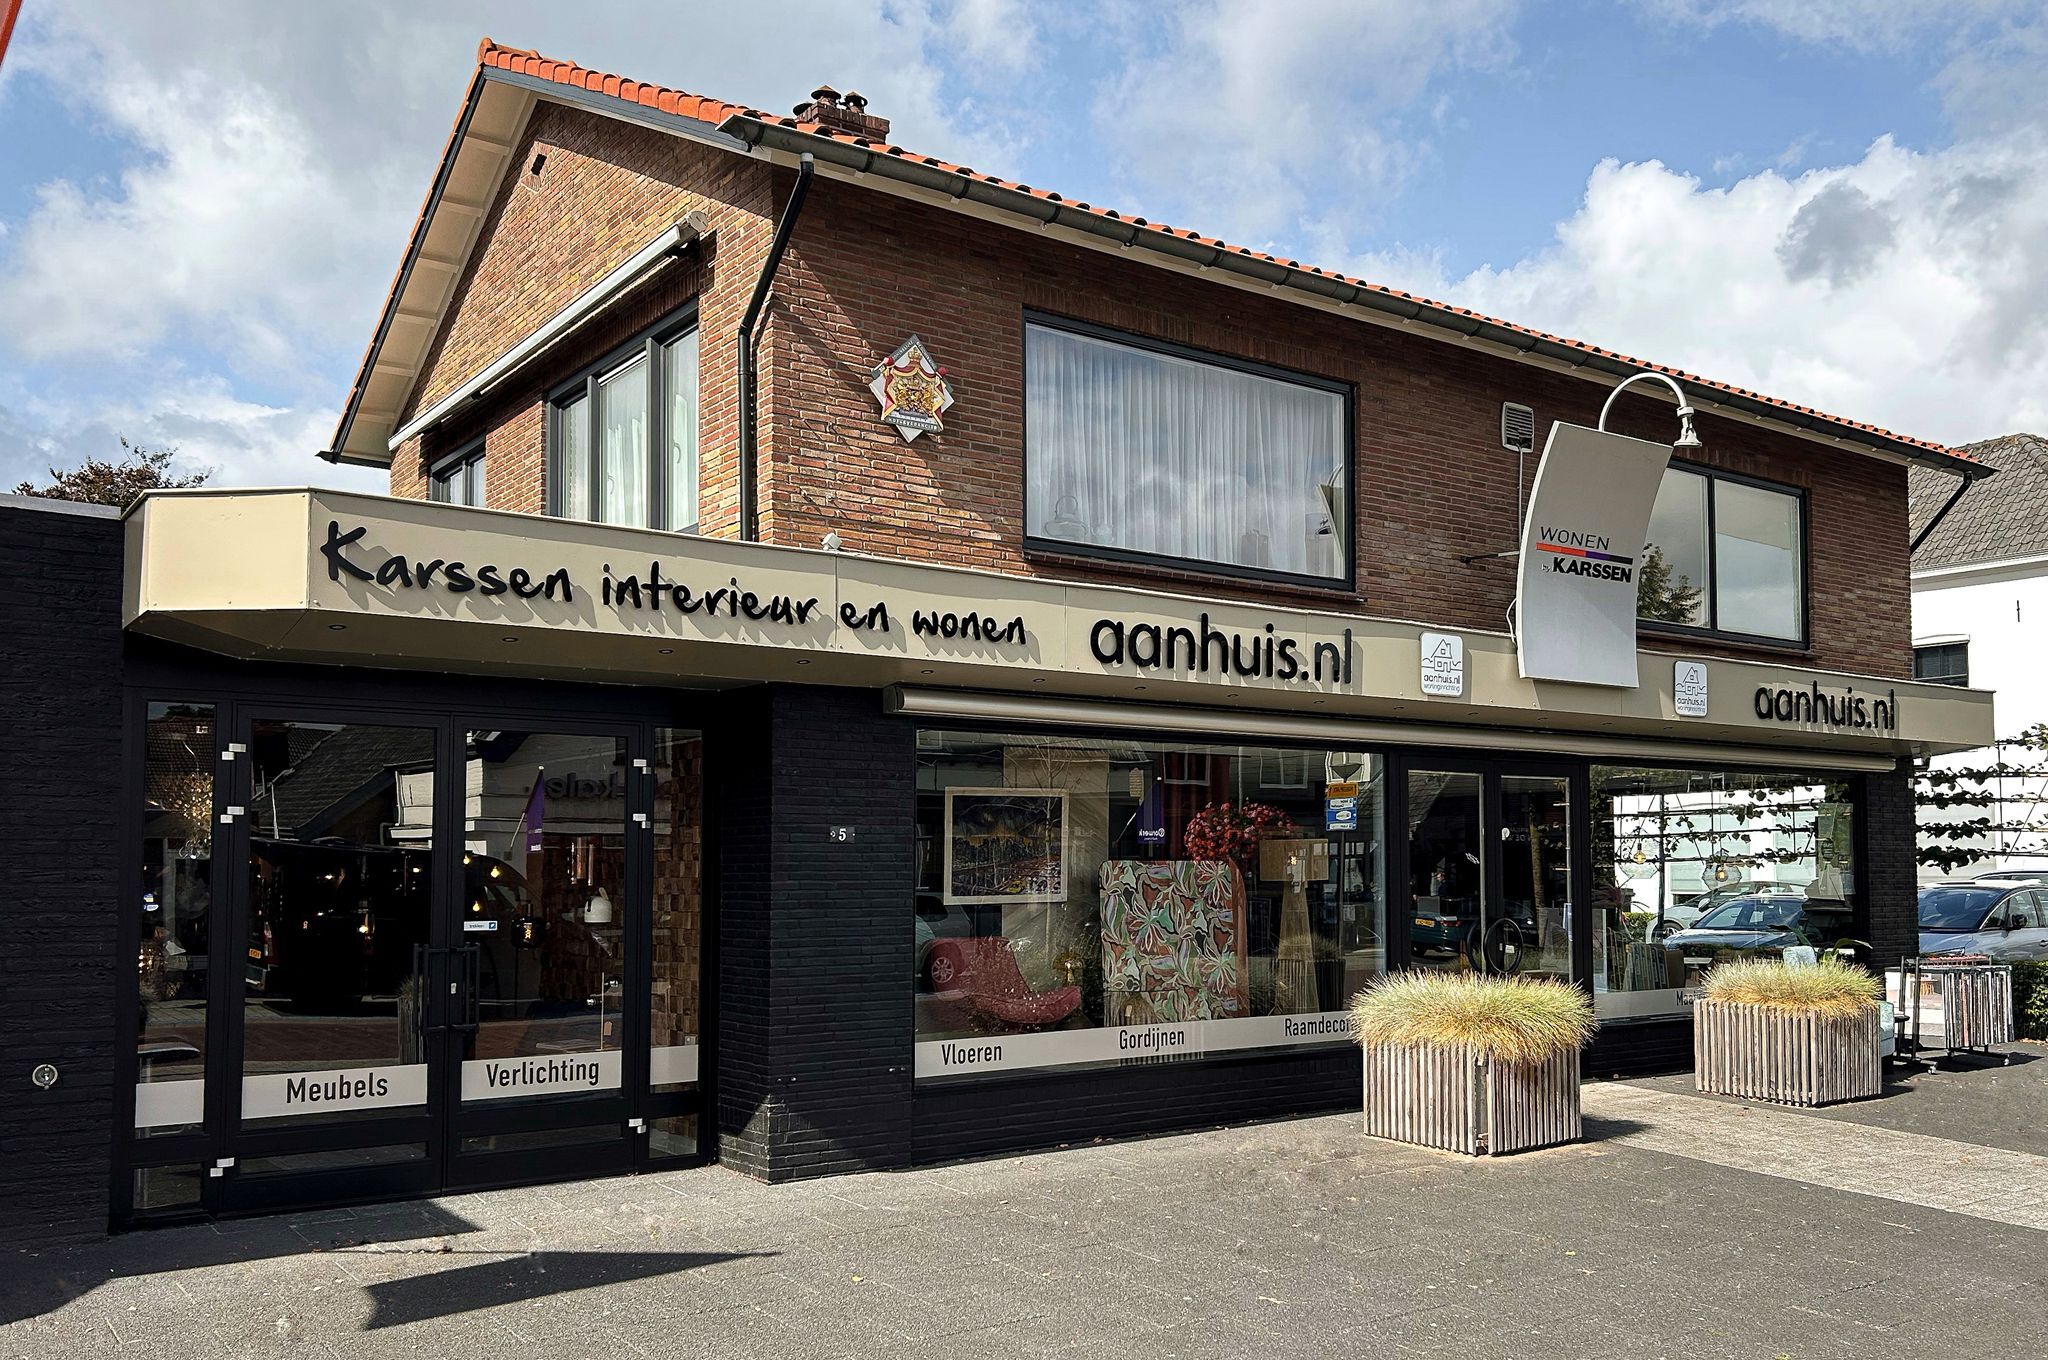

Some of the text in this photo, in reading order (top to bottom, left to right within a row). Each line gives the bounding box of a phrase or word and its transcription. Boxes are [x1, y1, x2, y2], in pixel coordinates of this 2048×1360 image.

[1540, 526, 1610, 551] WONEN
[320, 520, 1027, 645] Karssen interieur en wonen
[1542, 556, 1633, 583] by KARSSEN
[1090, 612, 1352, 684] aanhuis.nl
[1423, 673, 1461, 685] aanhuis.nl
[1755, 680, 1895, 730] aanhuis.nl
[838, 828, 847, 841] 5
[941, 1042, 1003, 1066] Vloeren
[1119, 1029, 1185, 1053] Gordijnen
[485, 1057, 600, 1088] Verlichting
[286, 1072, 389, 1104] Meubels
